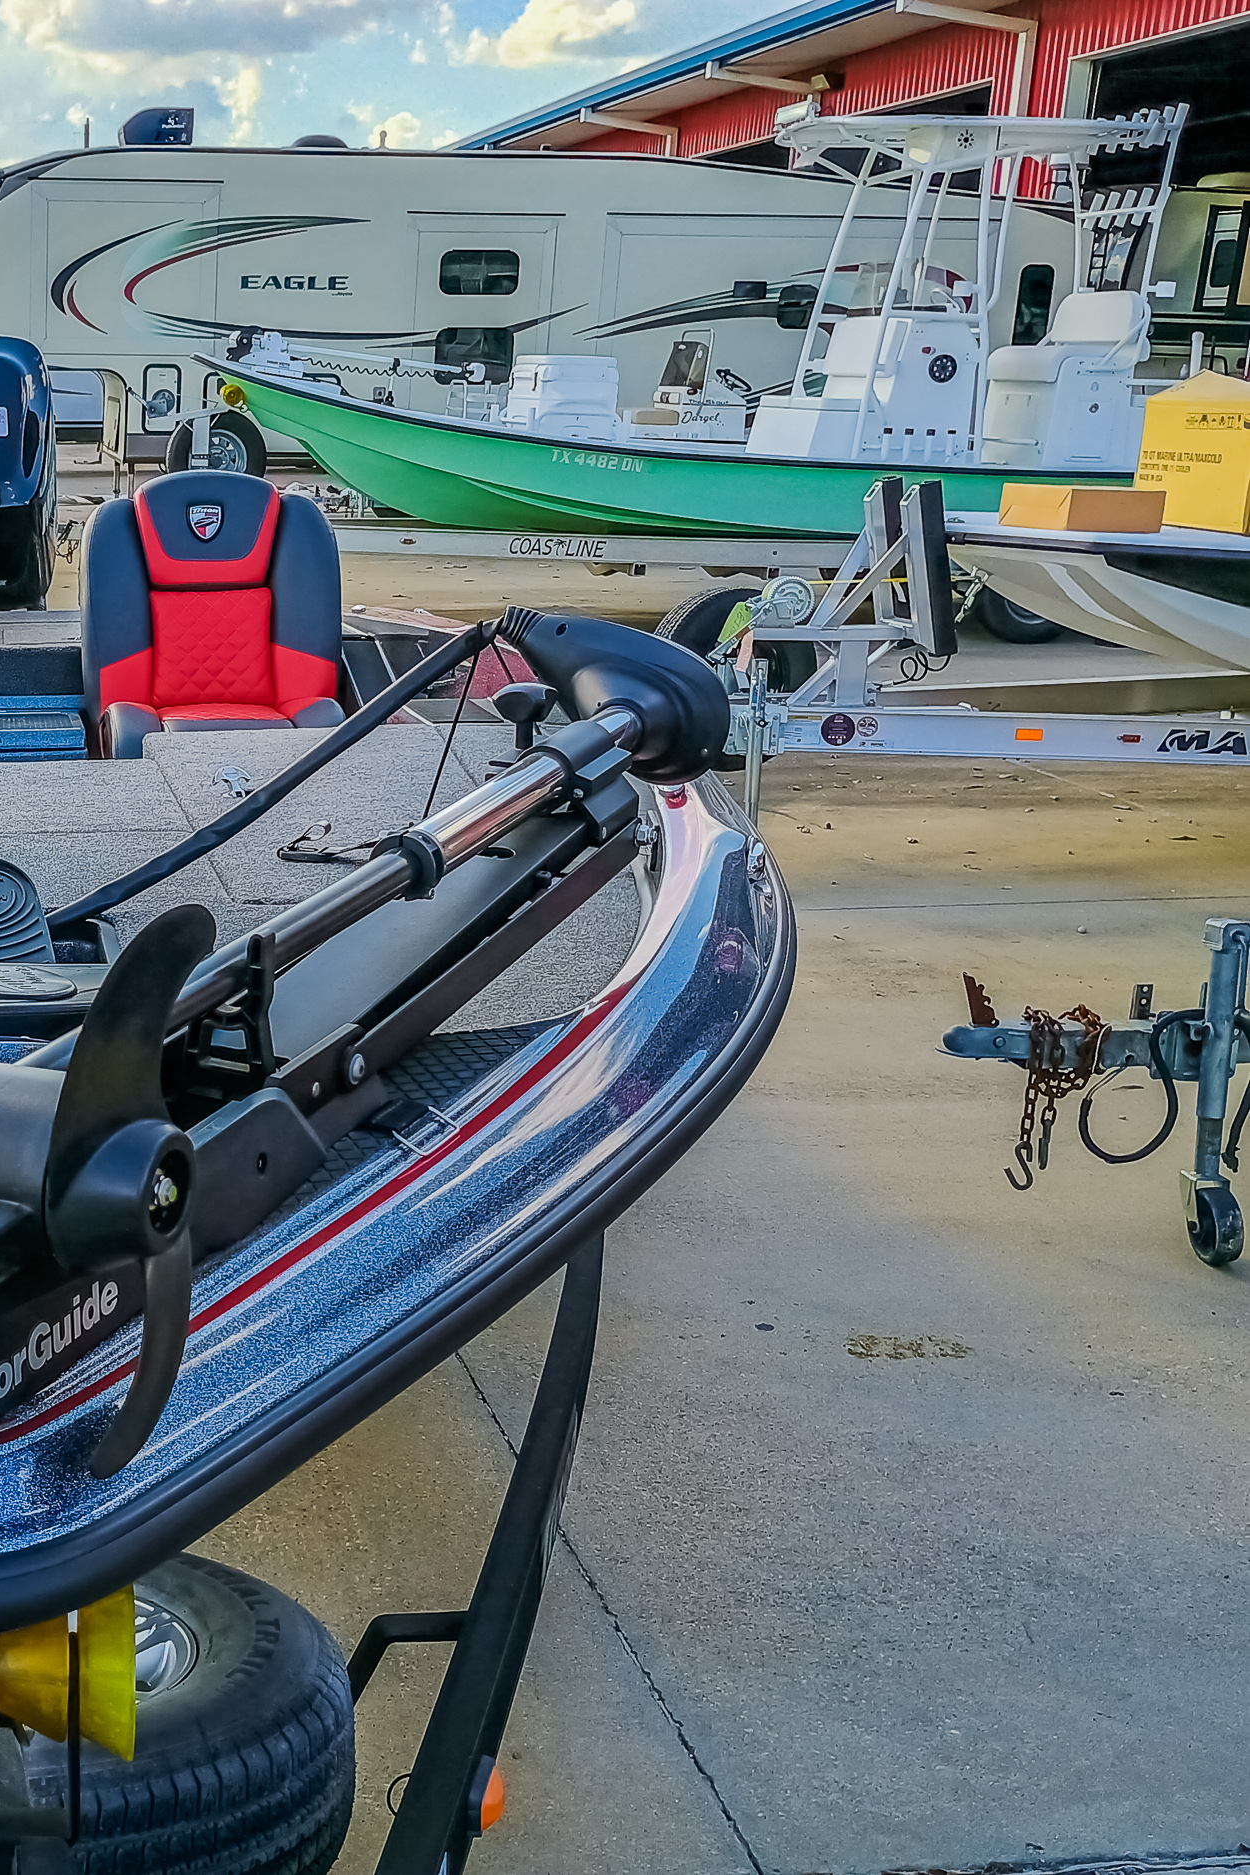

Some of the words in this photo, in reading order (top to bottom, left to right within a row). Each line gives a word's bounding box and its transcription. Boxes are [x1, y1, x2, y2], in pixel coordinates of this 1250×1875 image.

[240, 275, 349, 290] EAGLE
[681, 411, 720, 424] Dargel
[552, 449, 572, 464] TX
[575, 453, 618, 470] 4482
[621, 458, 644, 473] DN
[1157, 451, 1176, 462] MARINE
[1156, 729, 1249, 755] MA
